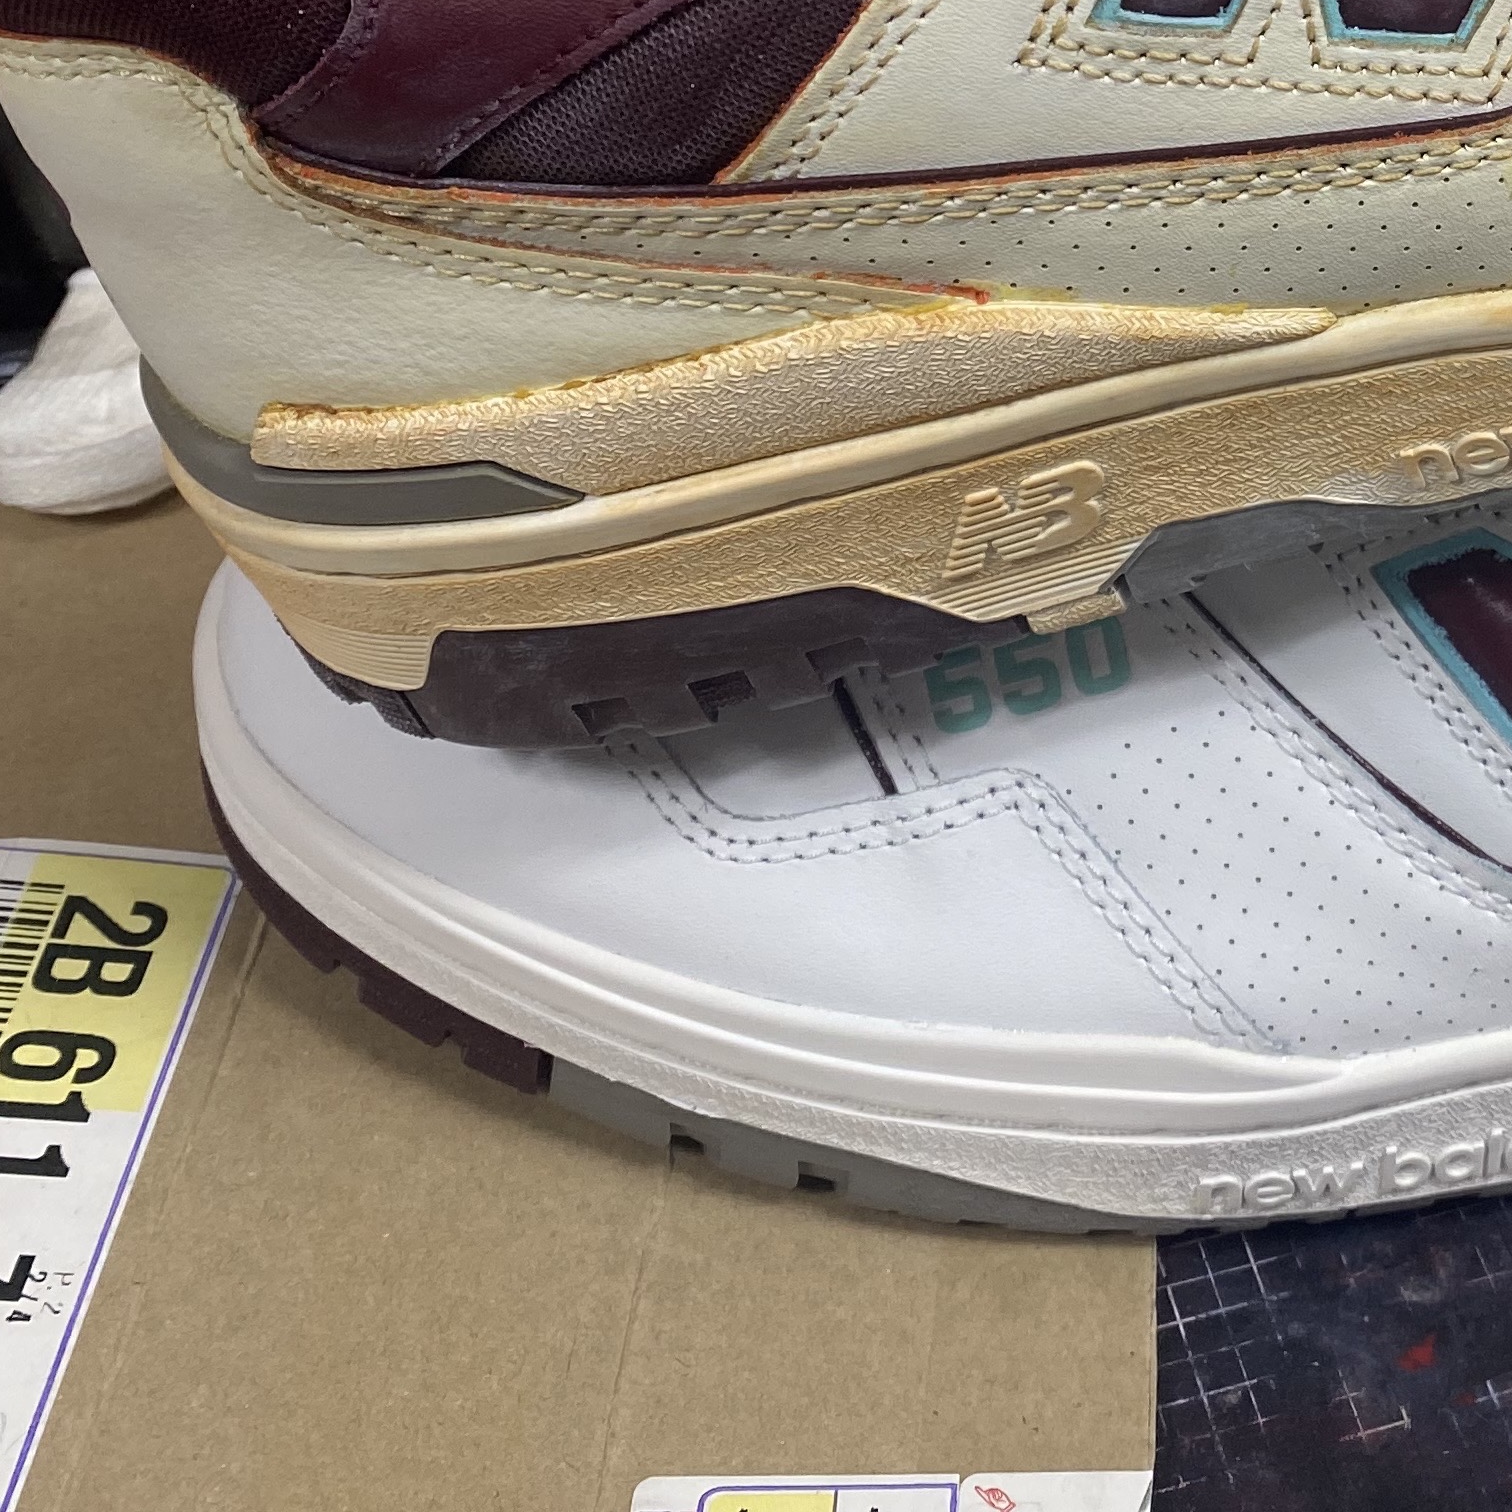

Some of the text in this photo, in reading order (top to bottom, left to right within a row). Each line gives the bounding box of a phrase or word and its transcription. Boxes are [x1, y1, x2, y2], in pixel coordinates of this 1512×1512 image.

[922, 614, 1133, 734] 550
[31, 894, 169, 998] 2B
[1199, 1160, 1366, 1212] new
